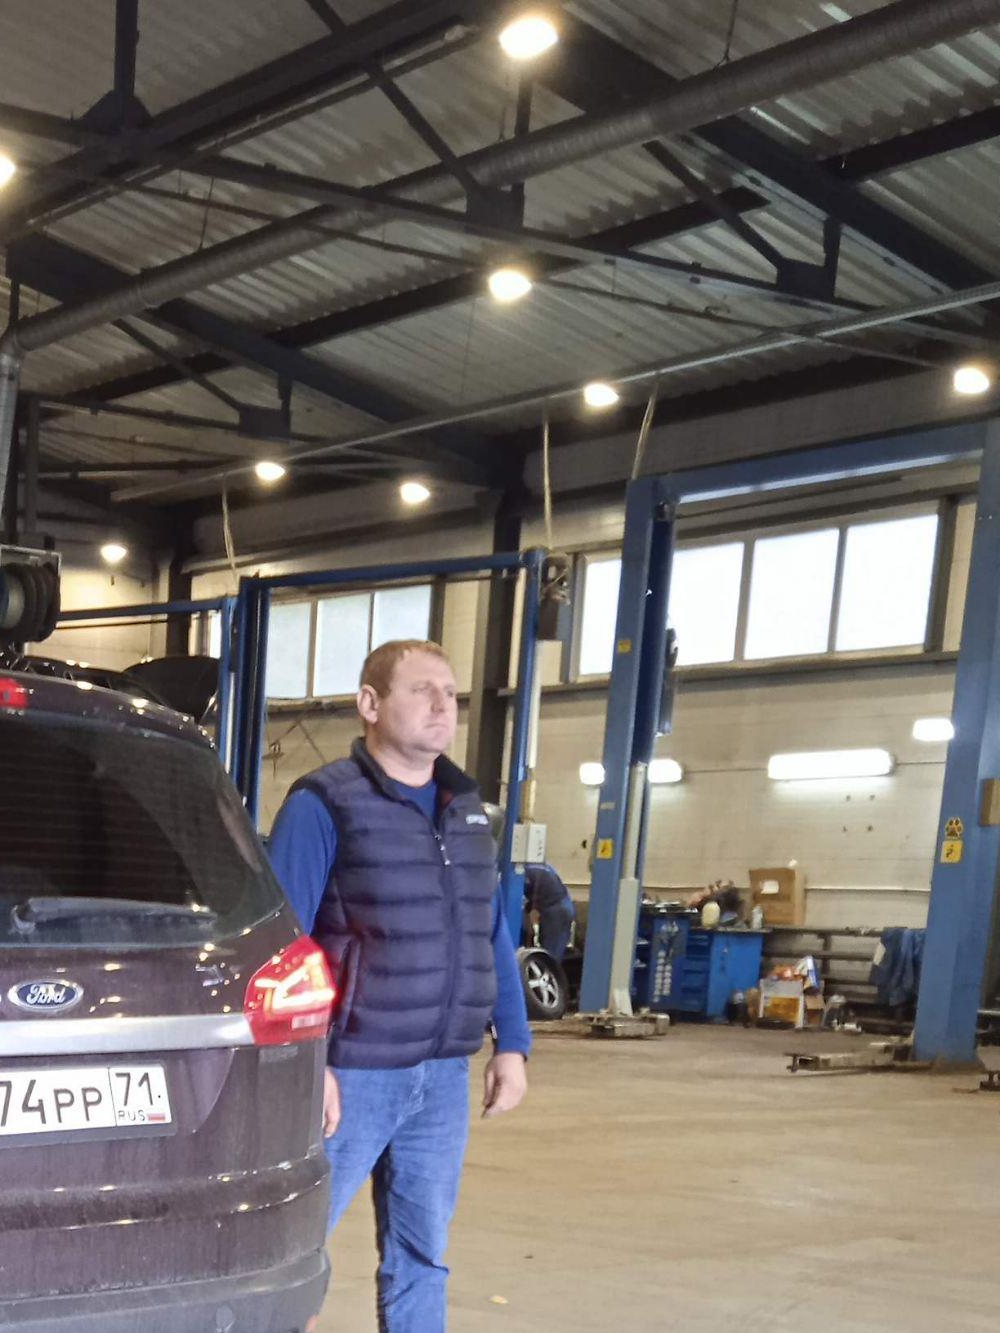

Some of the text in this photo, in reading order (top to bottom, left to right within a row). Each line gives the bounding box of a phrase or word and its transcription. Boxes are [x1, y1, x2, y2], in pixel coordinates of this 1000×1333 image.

[26, 984, 66, 1005] Ford
[115, 1072, 155, 1107] 71
[117, 1109, 146, 1122] RUS
